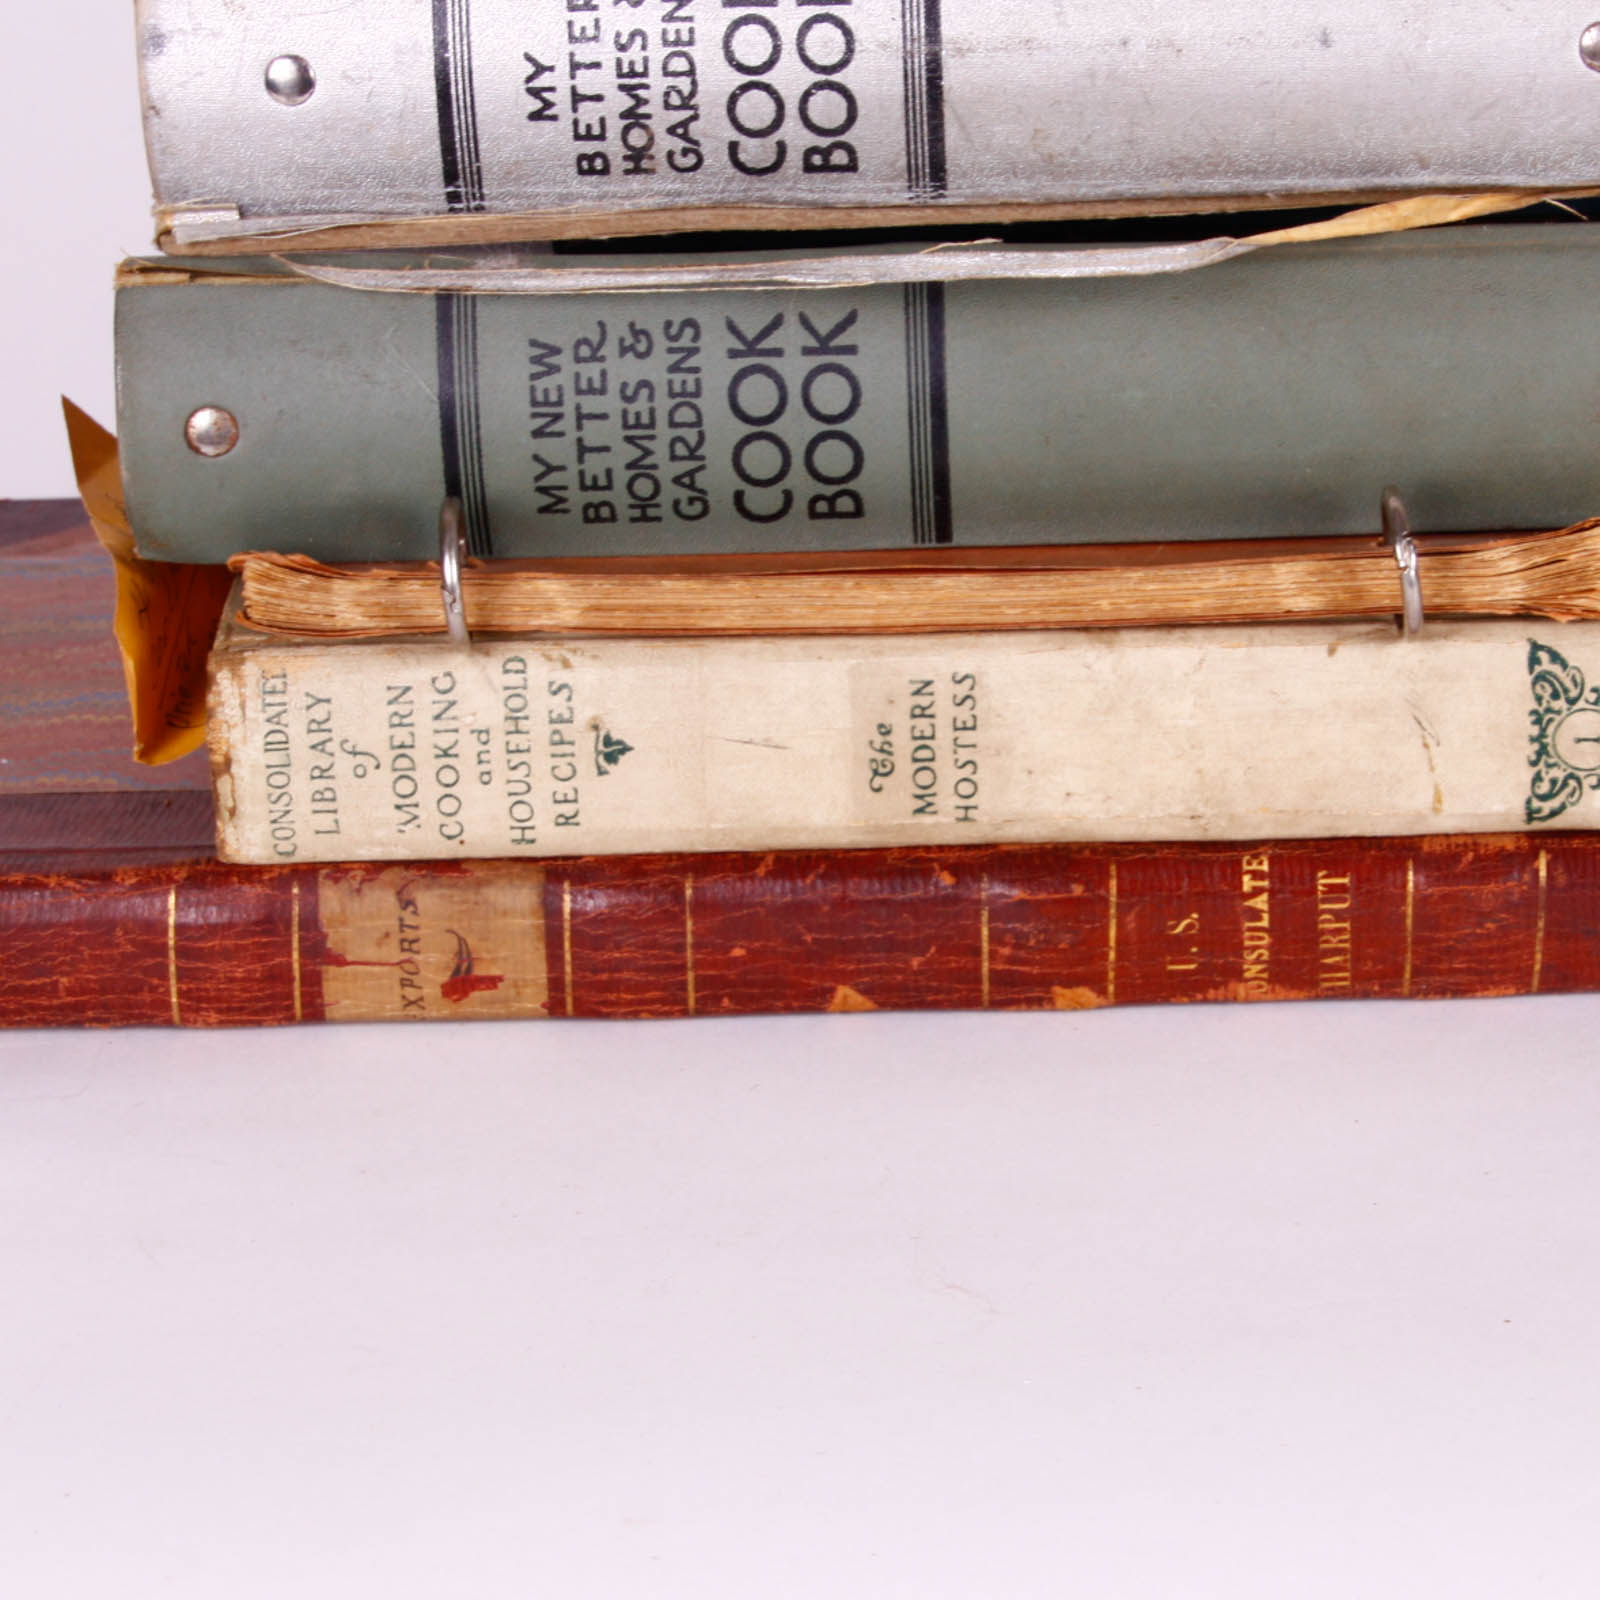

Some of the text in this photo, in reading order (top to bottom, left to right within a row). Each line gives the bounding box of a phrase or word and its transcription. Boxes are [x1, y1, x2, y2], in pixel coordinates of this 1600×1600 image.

[524, 51, 560, 122] MY
[567, 0, 611, 176] BETTE
[614, 28, 657, 176] HOMES
[661, 0, 704, 174] GARDEN
[722, 0, 788, 177] COO
[796, 0, 859, 174] BOO
[528, 337, 572, 515] MY NEW
[573, 320, 618, 524] BETTER
[618, 321, 664, 524] HOMES &
[663, 317, 711, 522] GARDENS
[725, 311, 794, 524] COOK
[799, 308, 865, 521] BOOK
[305, 692, 341, 835] LIBRARY
[339, 739, 381, 779] of
[386, 685, 422, 834] MODERN
[431, 670, 465, 840] COOKING
[470, 727, 492, 786] and
[501, 656, 537, 846] HOUSEHOLD
[548, 680, 581, 827] RECIPES
[868, 722, 895, 793] The
[909, 679, 938, 816] MODERN
[951, 672, 979, 823] HOSTESS
[397, 893, 426, 1016] XPORTS
[1242, 854, 1270, 993] ONSULATE
